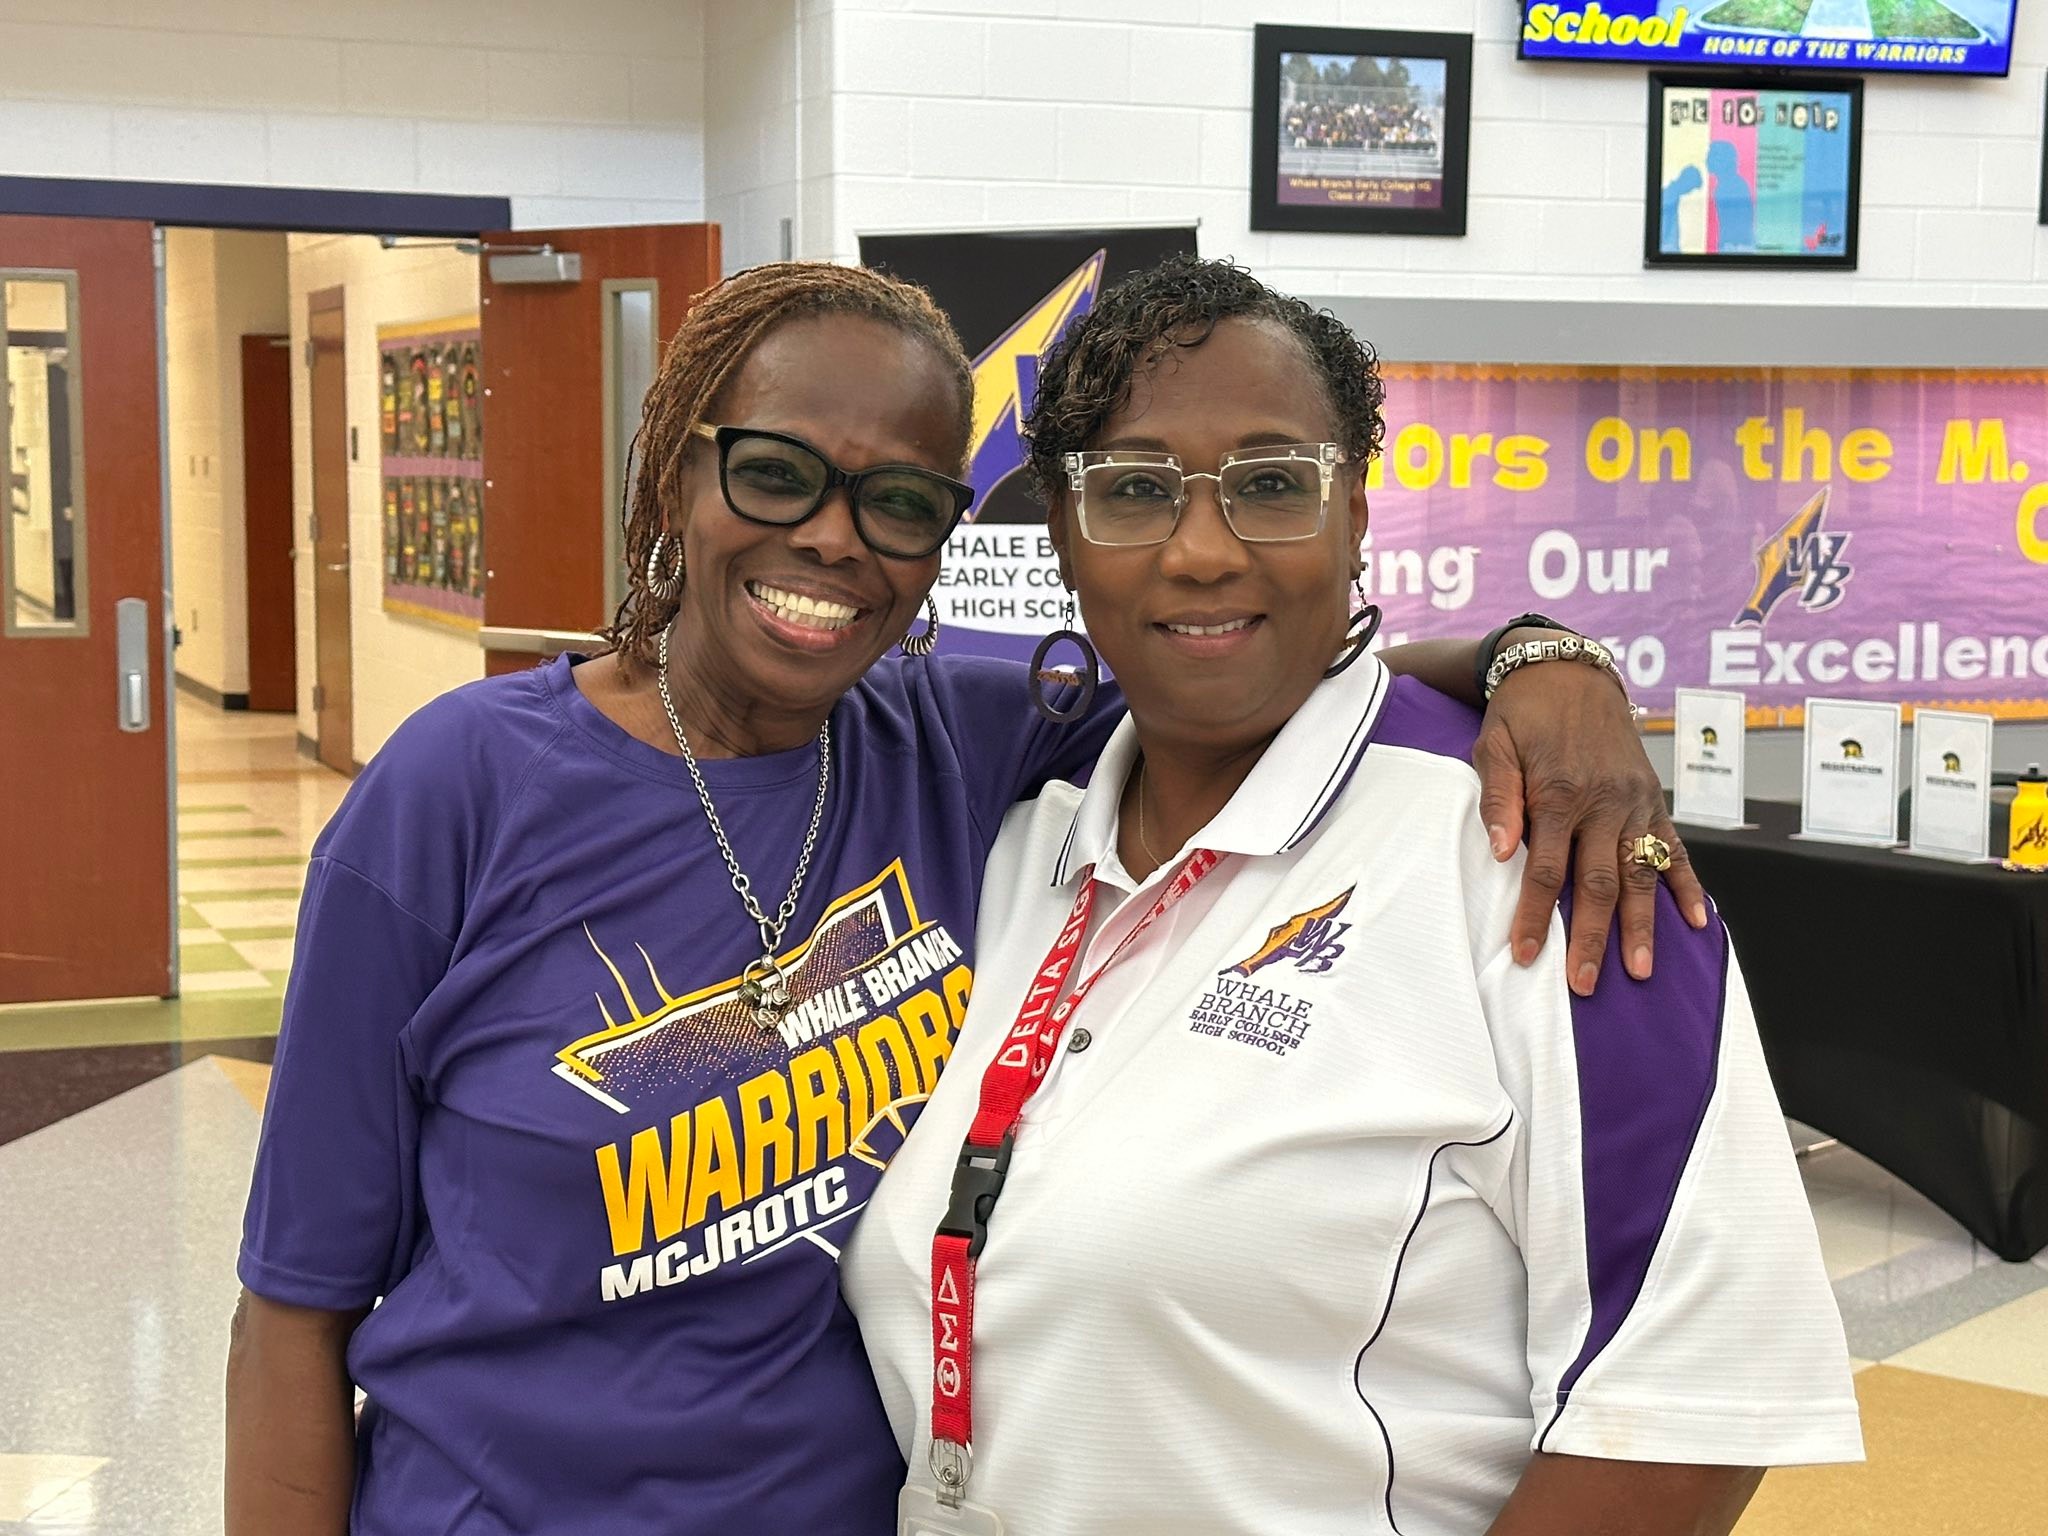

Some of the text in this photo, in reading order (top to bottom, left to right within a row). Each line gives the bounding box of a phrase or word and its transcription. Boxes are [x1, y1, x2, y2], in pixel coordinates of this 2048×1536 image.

[1524, 3, 1689, 47] School
[1703, 36, 1967, 64] HOME OF THE WARRIORS
[1722, 96, 1766, 127] for
[1586, 417, 1691, 483] On
[1735, 408, 1893, 483] the
[1936, 419, 2029, 484] M.
[938, 568, 1019, 587] EARLY
[1528, 529, 1669, 599] Our
[952, 599, 1016, 618] HIGH
[777, 979, 867, 1051] WHALE
[998, 957, 1067, 1068] DELTA
[1197, 993, 1311, 1040] BRANCH
[1216, 977, 1313, 1019] WHALE
[1189, 1010, 1300, 1049] EARLY COLLEGE
[1190, 1022, 1286, 1056] HIGH SCHOOL
[600, 1166, 848, 1301] MCJROTC
